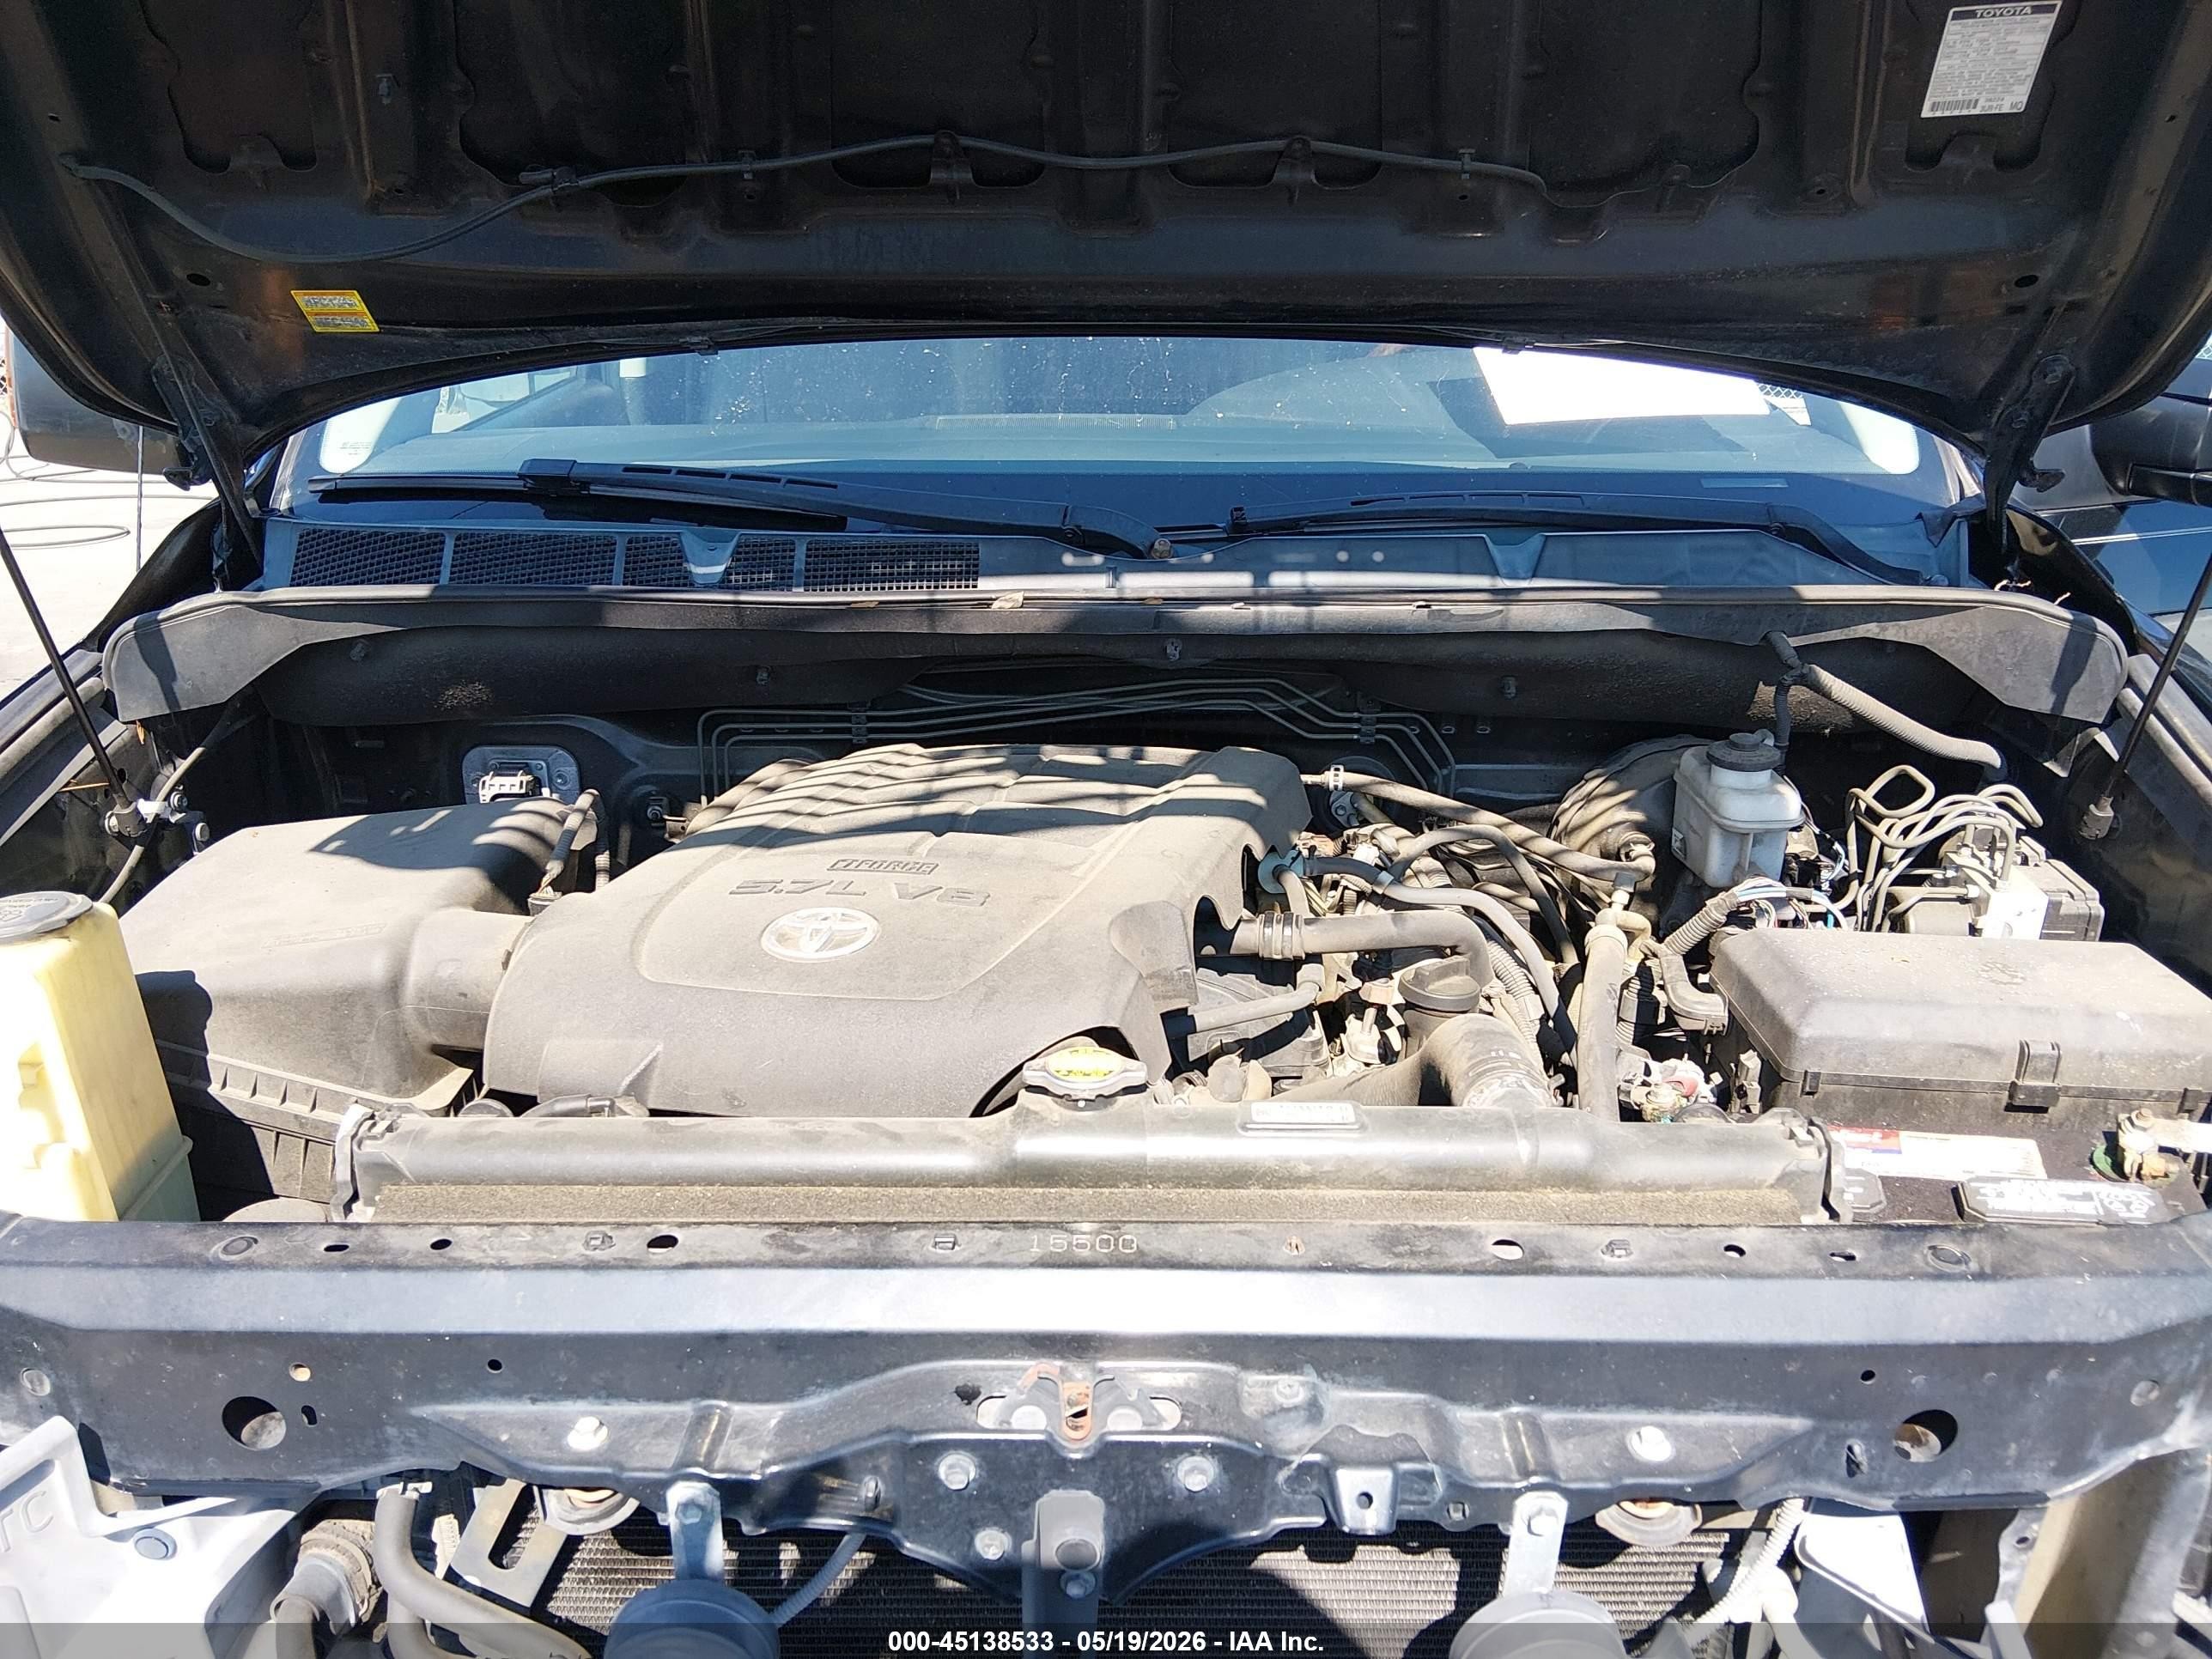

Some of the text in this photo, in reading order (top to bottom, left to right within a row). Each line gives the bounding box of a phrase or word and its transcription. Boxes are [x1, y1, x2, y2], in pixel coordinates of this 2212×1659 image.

[1975, 5, 2033, 18] TOYOTA
[729, 879, 991, 907] 5.7L V8
[1030, 1234, 1138, 1253] 15500
